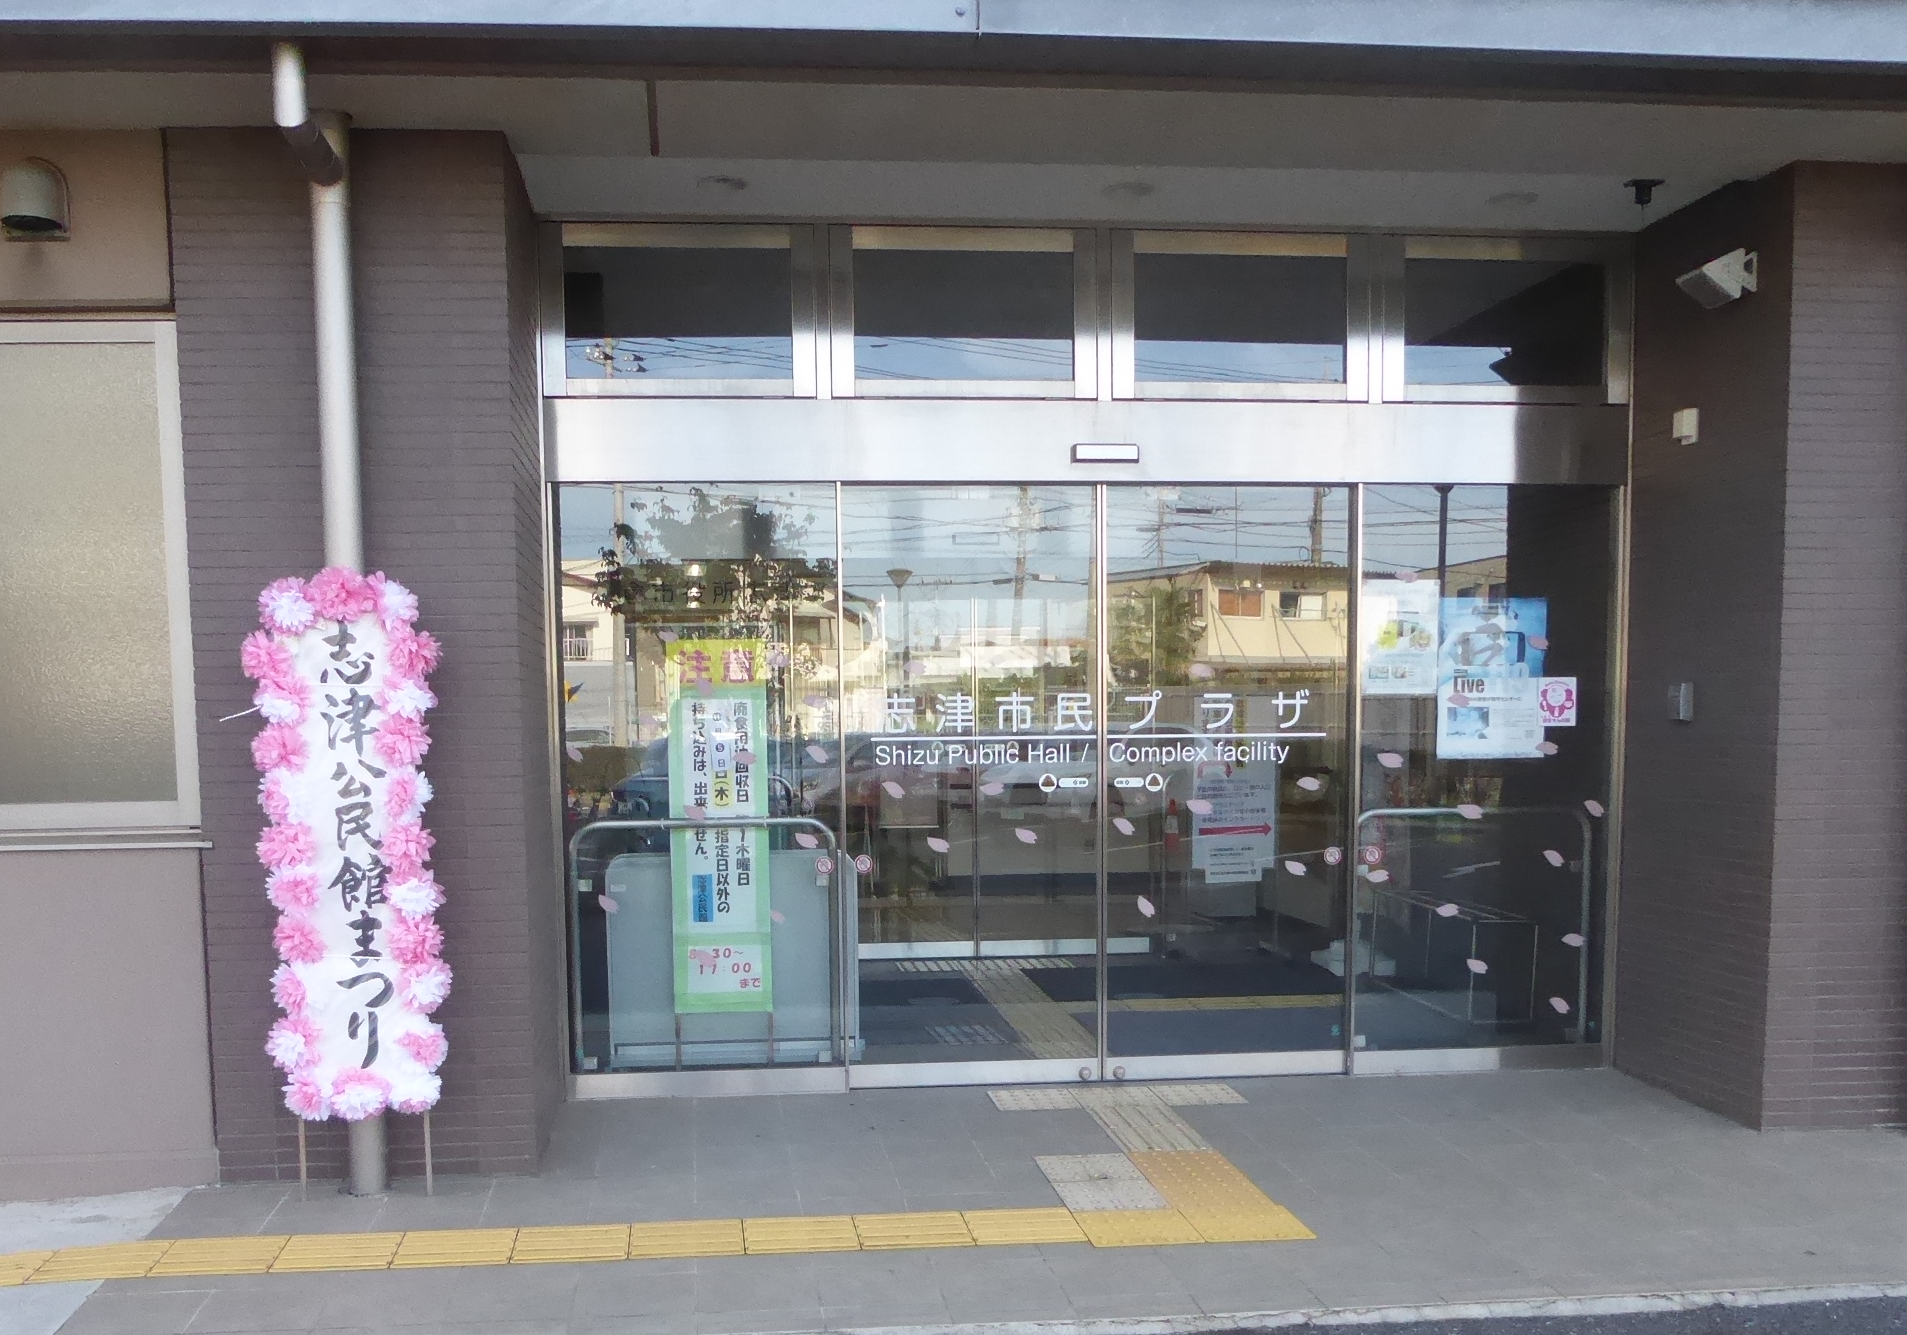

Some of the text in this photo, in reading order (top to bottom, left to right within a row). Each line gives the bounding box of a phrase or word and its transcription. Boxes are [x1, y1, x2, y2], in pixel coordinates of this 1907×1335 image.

[679, 649, 755, 684] 注意
[878, 689, 1310, 733] 志津市民プラザ
[875, 744, 939, 766] Shizu
[949, 743, 1019, 766] Public
[1028, 743, 1070, 764] Hall
[1109, 742, 1208, 765] Complex
[1214, 741, 1290, 764] facility
[320, 620, 394, 1069] 志津公民館まつり
[715, 829, 730, 913] 指定日以外の
[739, 978, 761, 989] まで
